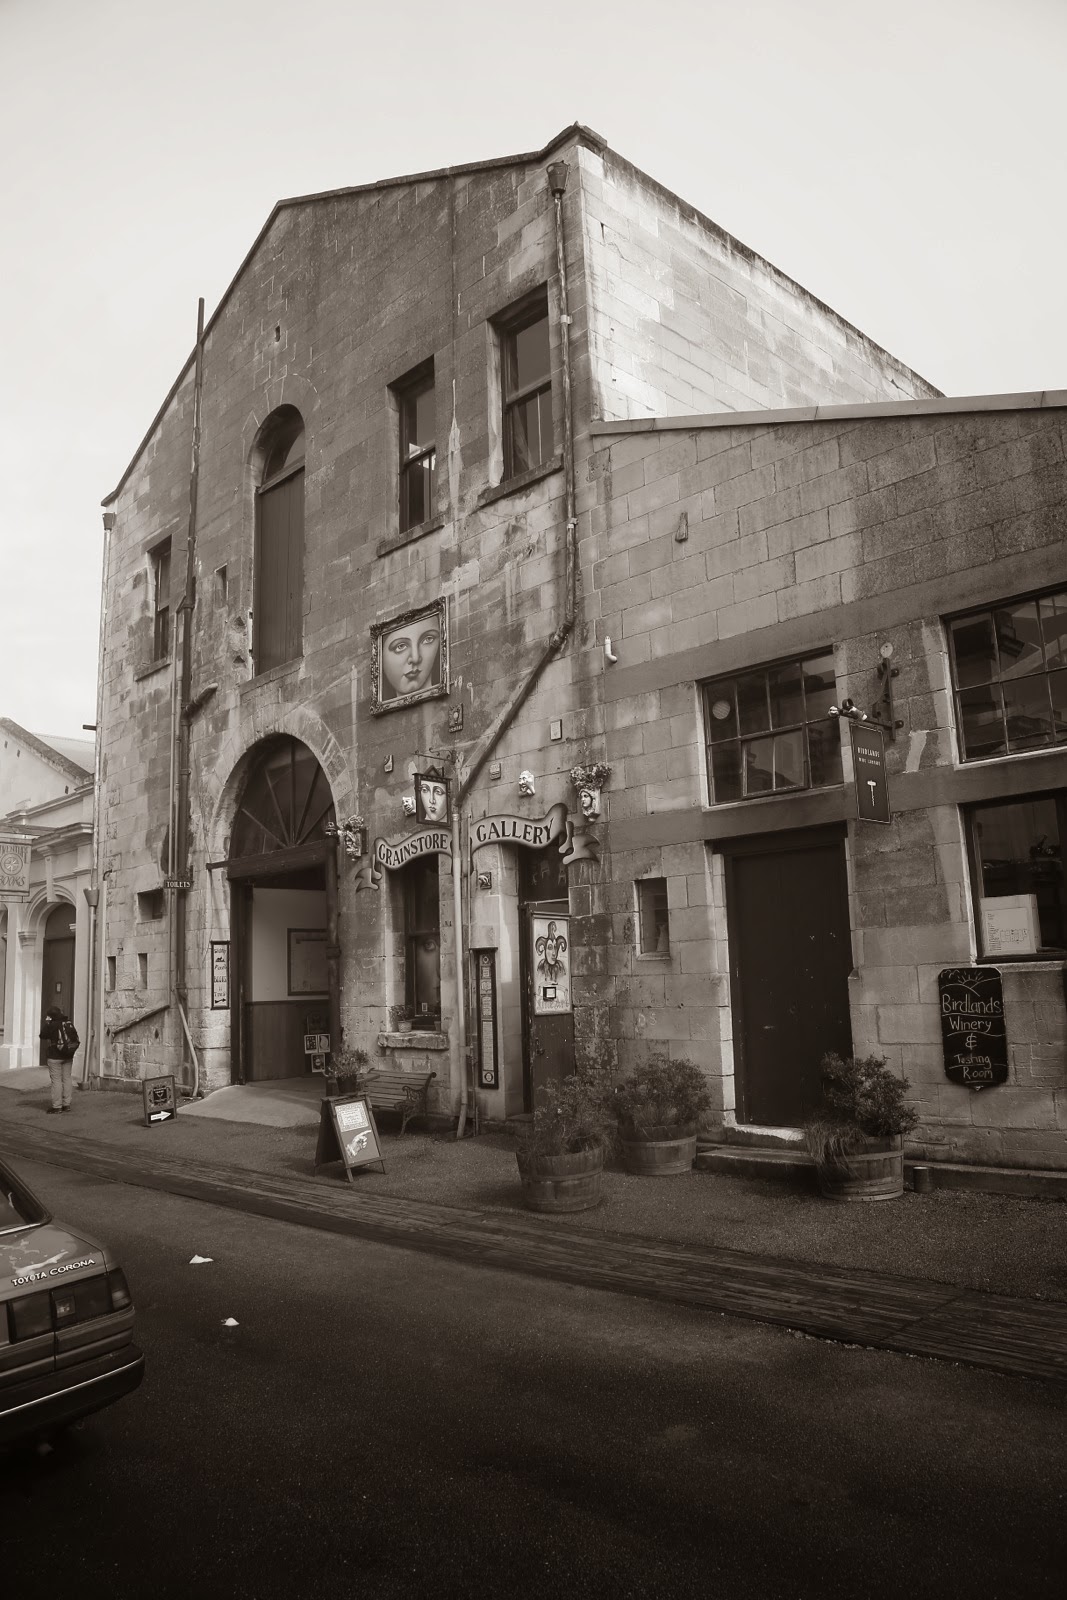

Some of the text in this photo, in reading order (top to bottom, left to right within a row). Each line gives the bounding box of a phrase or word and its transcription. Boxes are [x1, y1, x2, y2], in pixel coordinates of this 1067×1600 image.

[378, 817, 554, 867] GRAINSTORE GALLERY
[948, 1016, 992, 1032] Winery
[963, 1067, 993, 1080] Room
[11, 1258, 96, 1287] TOYOTA CORONA
